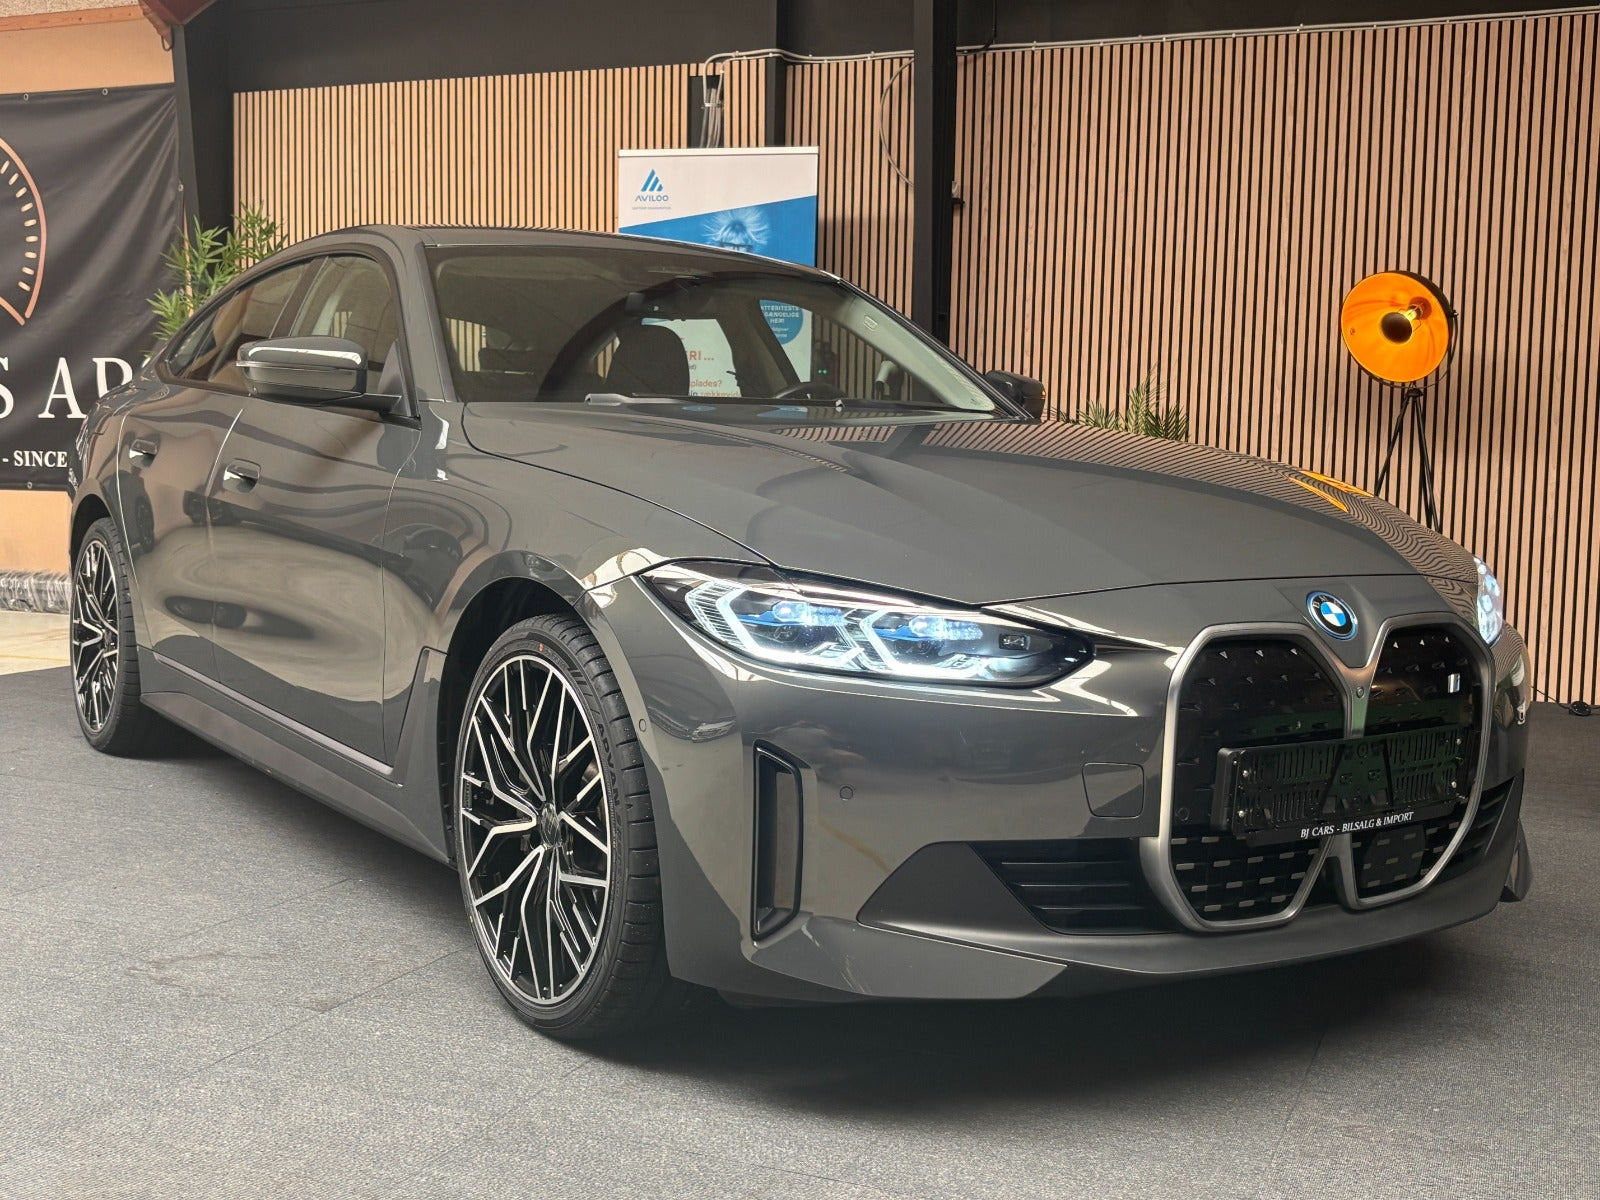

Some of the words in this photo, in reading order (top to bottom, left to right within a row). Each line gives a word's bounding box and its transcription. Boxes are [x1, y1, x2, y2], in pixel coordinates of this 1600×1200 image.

[634, 194, 670, 202] AVILOO
[38, 357, 133, 419] AP
[13, 450, 68, 468] SINCE
[1300, 828, 1309, 839] BJ
[1311, 825, 1335, 836] CARS
[1342, 818, 1375, 833] BILSALG
[1375, 816, 1382, 827] &
[1383, 811, 1414, 826] IMPORT
